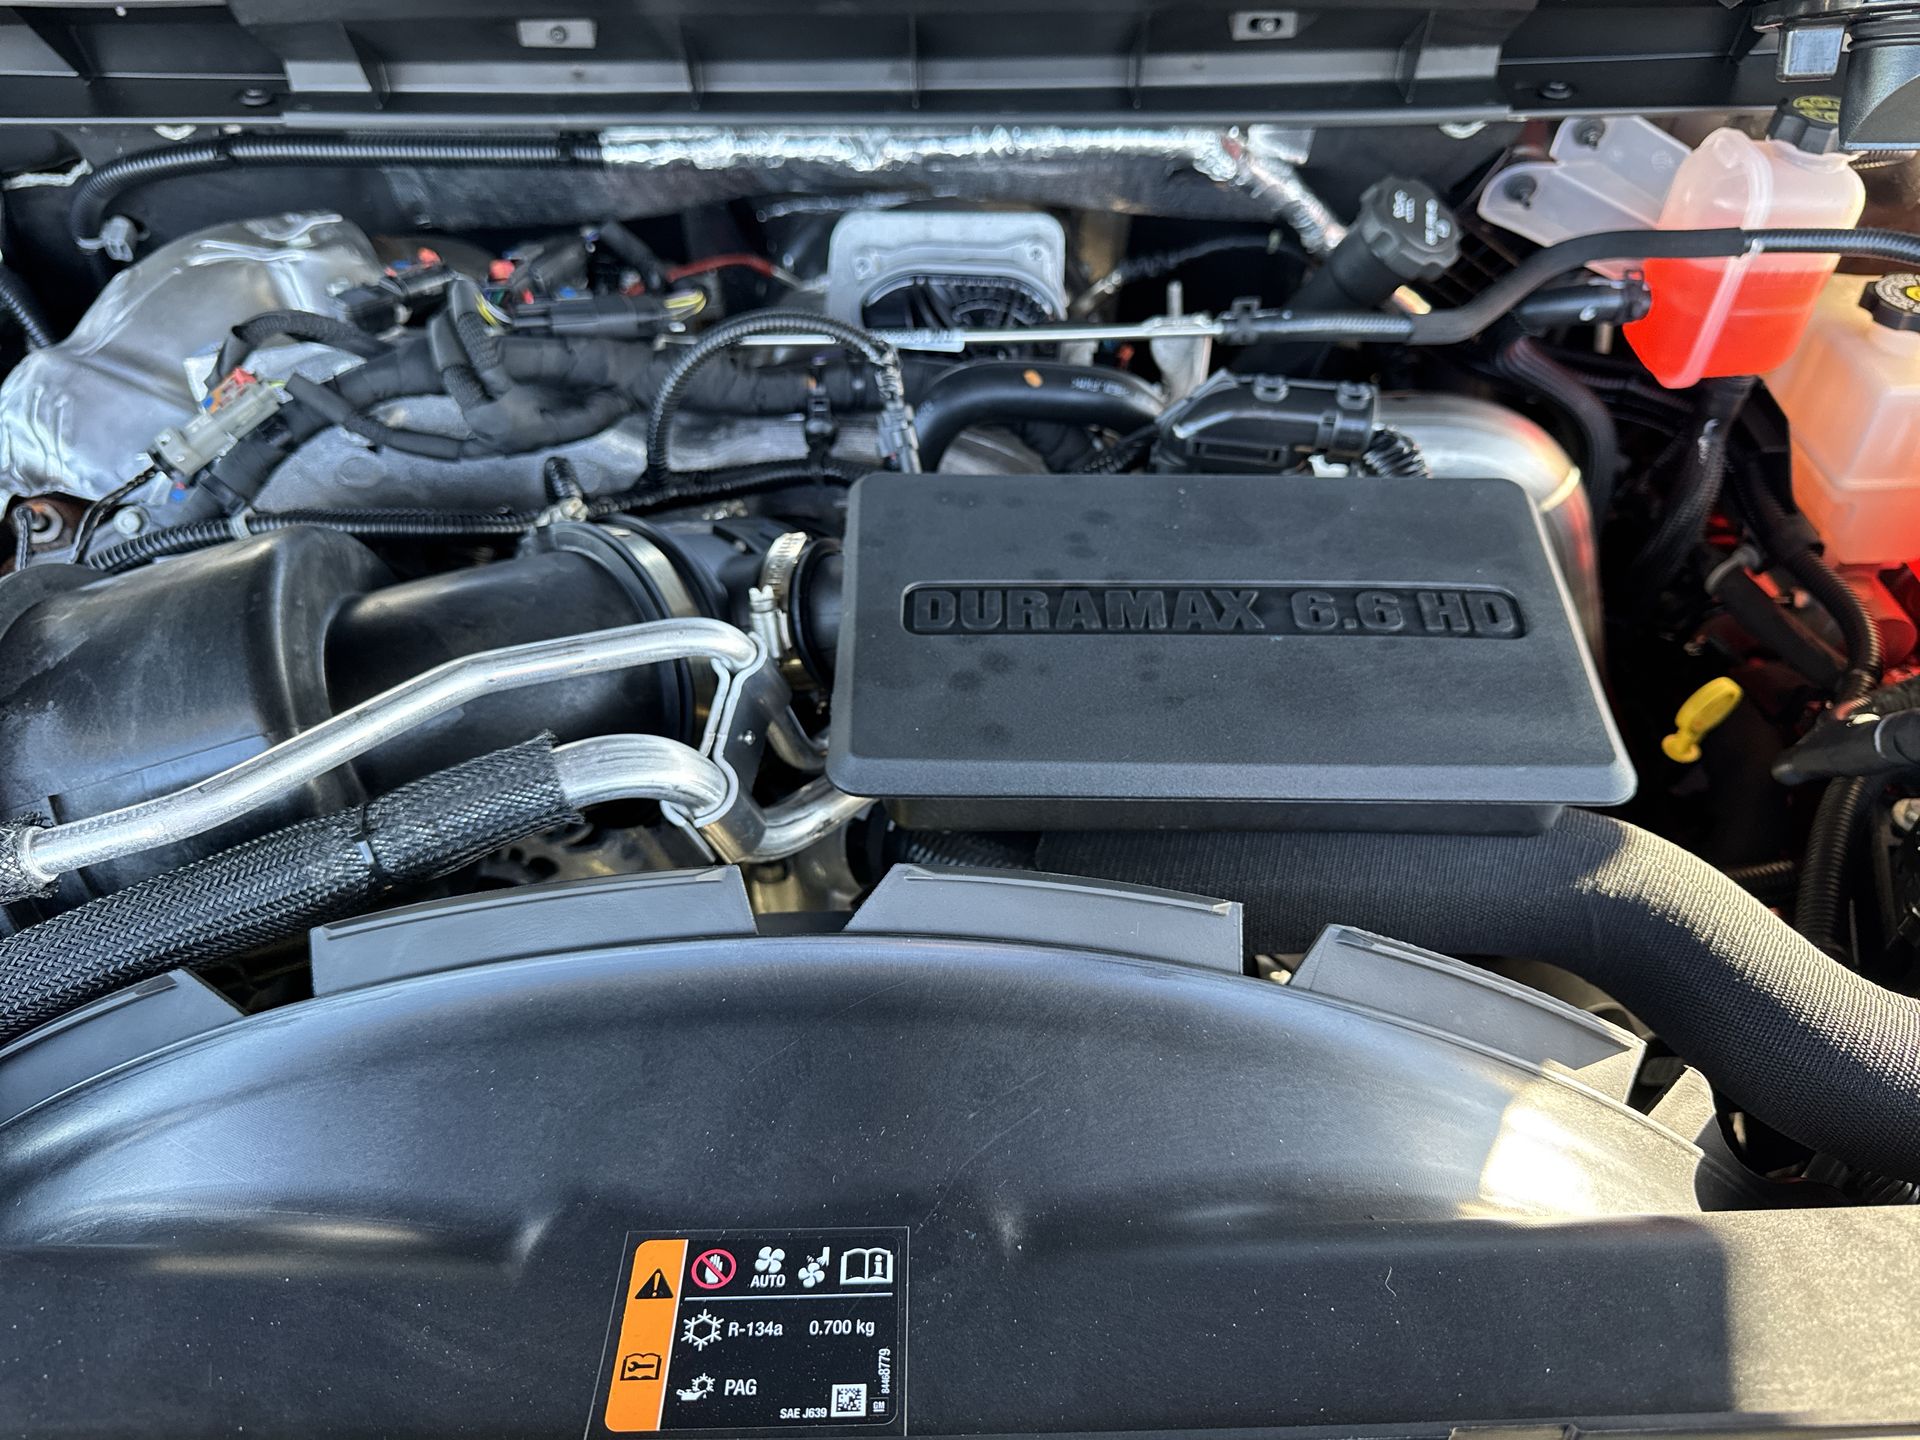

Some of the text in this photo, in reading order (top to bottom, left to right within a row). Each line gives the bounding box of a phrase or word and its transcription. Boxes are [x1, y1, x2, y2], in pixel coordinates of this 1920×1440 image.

[913, 590, 1516, 632] DURAMAX 6.6 HD
[750, 1274, 786, 1288] AUTO
[728, 1319, 875, 1338] R-134a 0.700 kg
[878, 1348, 891, 1394] 84468779
[724, 1379, 758, 1396] PAG
[779, 1407, 828, 1419] SAE J639
[872, 1400, 886, 1410] GM
